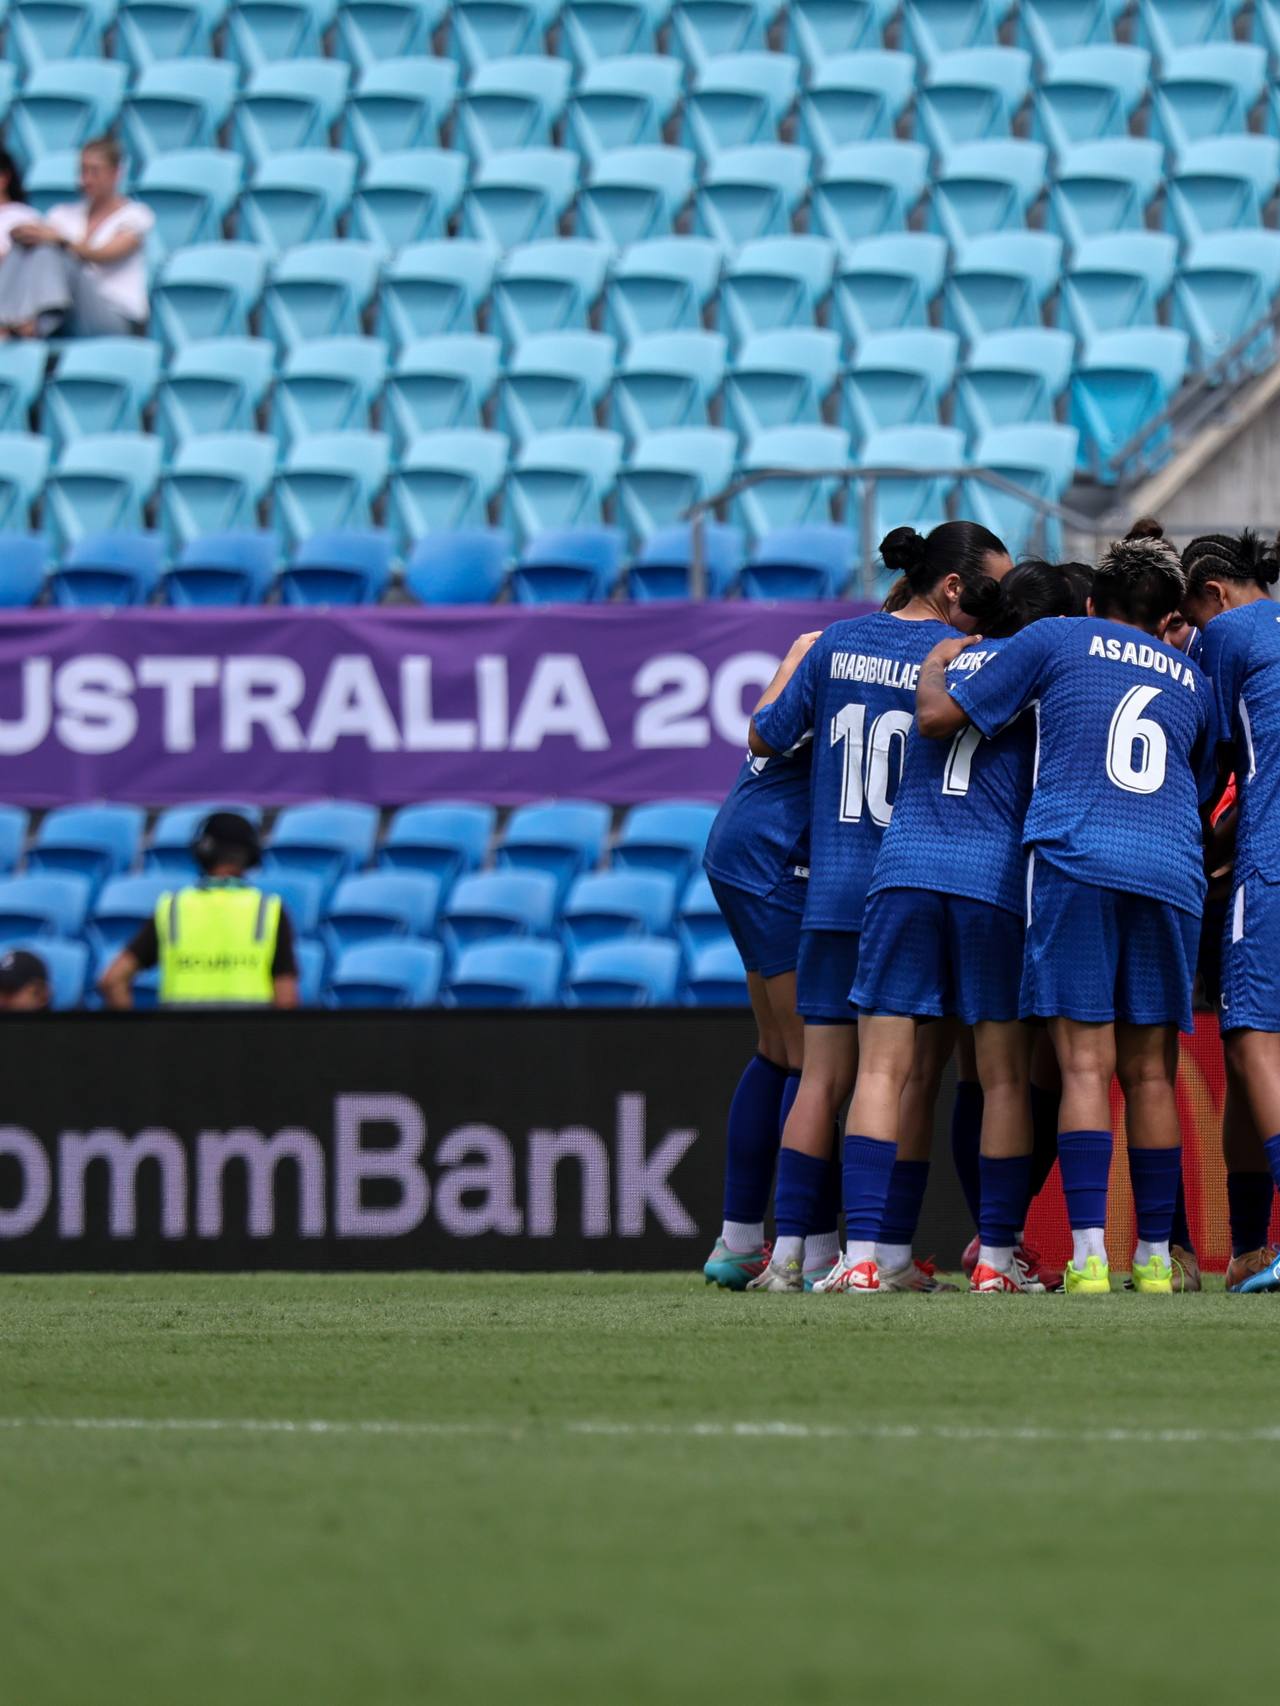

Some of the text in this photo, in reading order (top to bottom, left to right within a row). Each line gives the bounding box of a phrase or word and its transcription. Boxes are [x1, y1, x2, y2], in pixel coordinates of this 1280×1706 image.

[0, 655, 612, 755] USTRALIA
[1088, 635, 1196, 692] ASADOVA
[830, 703, 915, 828] 10
[1105, 684, 1168, 795] 6
